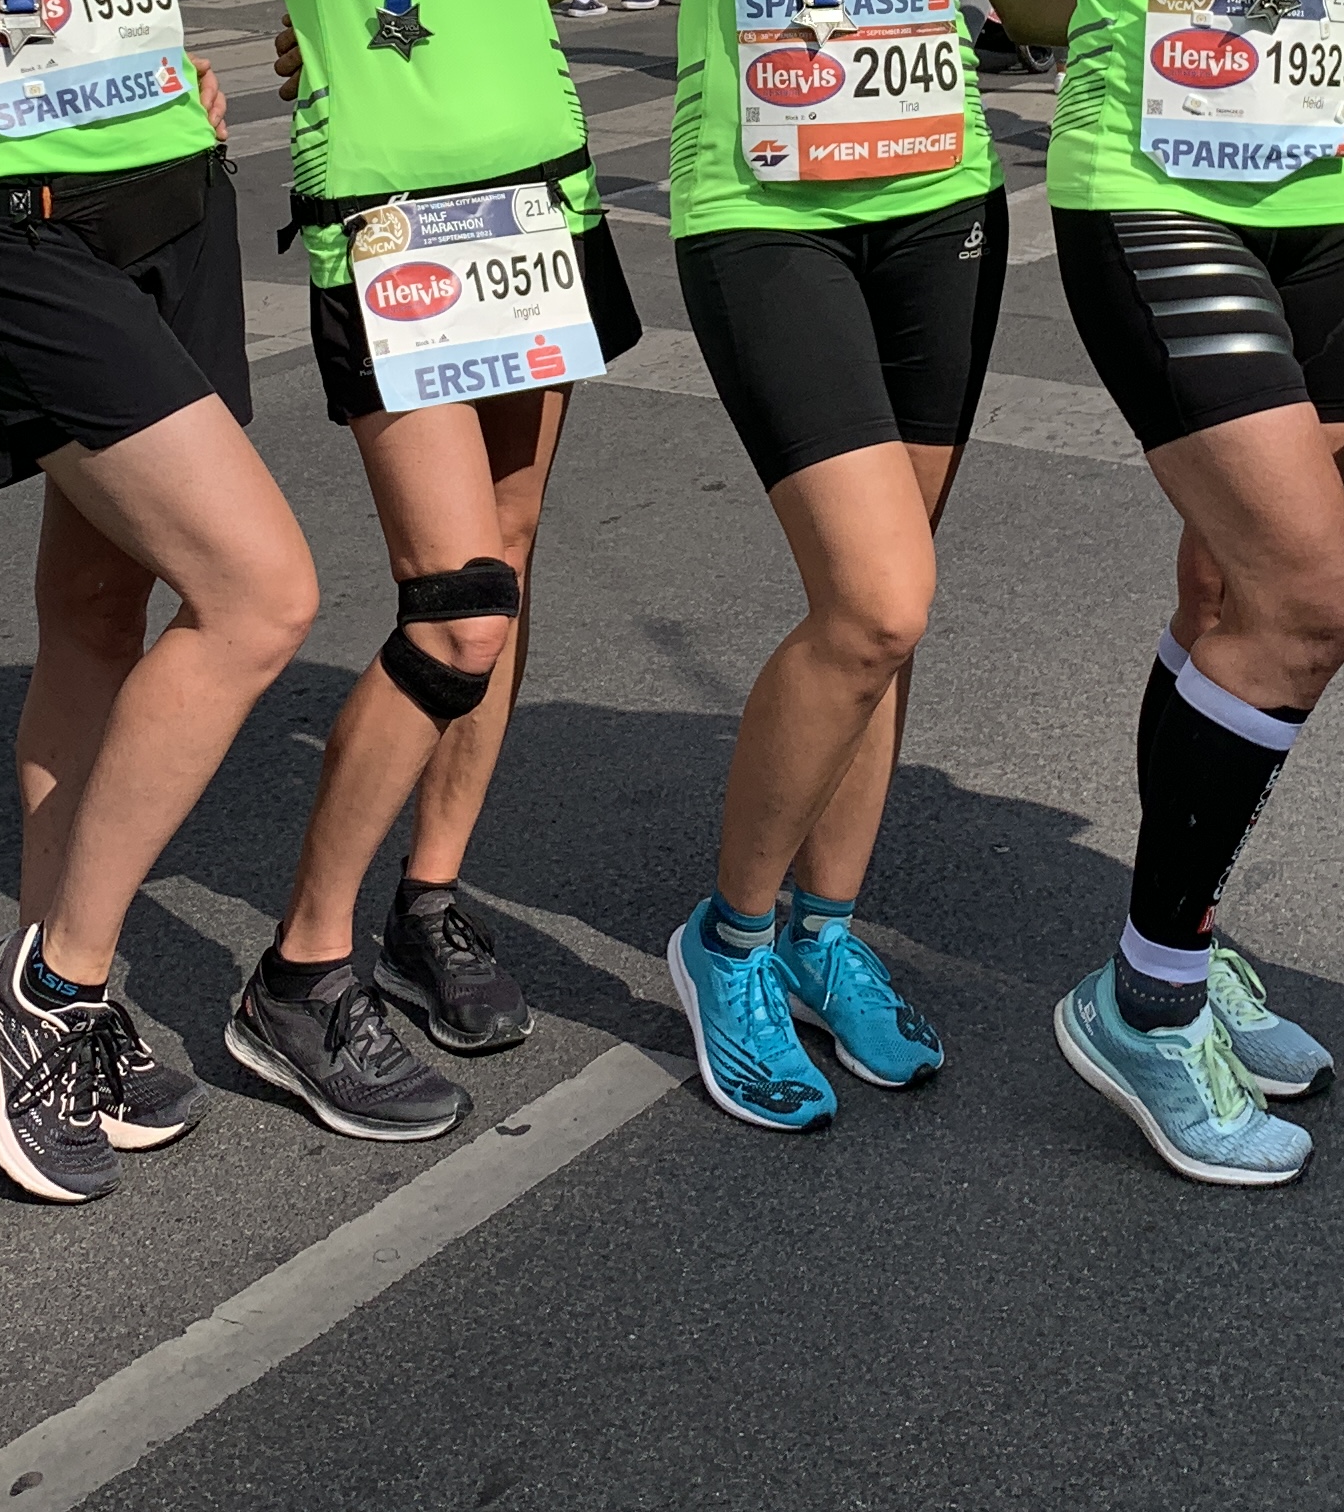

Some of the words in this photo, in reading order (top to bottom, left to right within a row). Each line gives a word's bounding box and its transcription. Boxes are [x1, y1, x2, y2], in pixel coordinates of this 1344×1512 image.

[1166, 0, 1196, 11] VCM
[119, 24, 150, 39] Claudia
[867, 28, 900, 37] SEPTEMBER
[1162, 40, 1250, 76] Hervis
[756, 61, 836, 94] Hervis
[853, 40, 958, 99] 2046
[899, 100, 919, 113] Tina
[1302, 96, 1325, 110] Heidi
[809, 141, 870, 161] WIEN
[877, 132, 957, 159] ENERGIE
[1151, 138, 1334, 171] SPARKASSE
[430, 201, 454, 210] VIENNA
[455, 198, 470, 206] CITY
[471, 193, 506, 204] MARATHON
[419, 211, 447, 223] HALF
[421, 218, 484, 236] MARATHON
[438, 232, 475, 244] SEPTEMBER
[369, 242, 396, 254] VCM
[466, 249, 575, 302] 19510
[375, 275, 455, 308] Hervis
[513, 304, 541, 321] Ingrid
[414, 352, 525, 400] ERSTE
